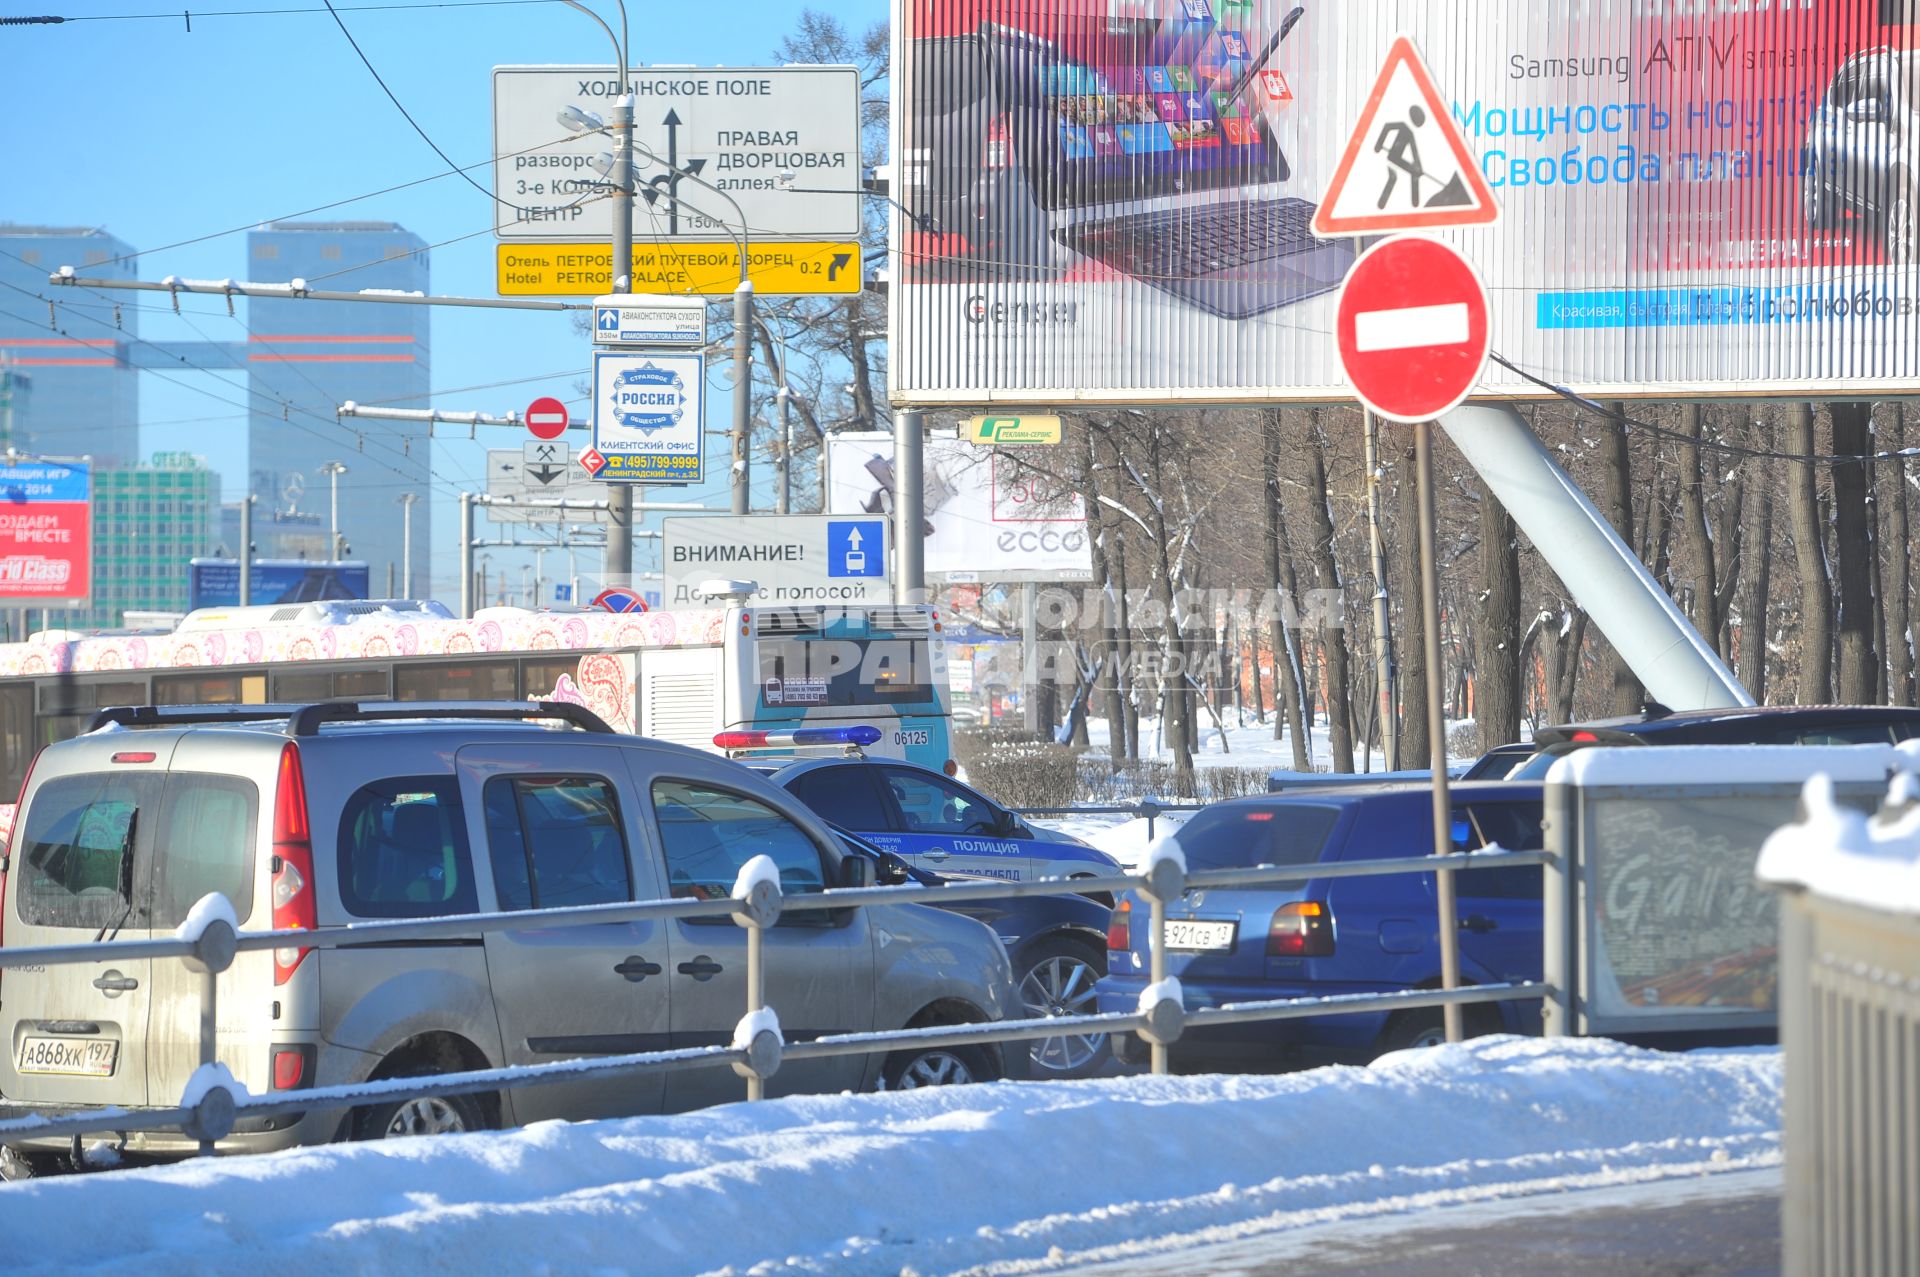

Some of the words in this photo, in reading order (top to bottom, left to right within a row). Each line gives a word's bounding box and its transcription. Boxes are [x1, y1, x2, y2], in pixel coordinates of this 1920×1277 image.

[1510, 54, 1629, 82] Samsung
[1643, 34, 1739, 74] ATIV
[578, 80, 709, 98] ХОДЫНСКОЕ
[716, 80, 771, 96] ПОЛЕ
[1451, 100, 1670, 142] Мощность
[717, 131, 798, 146] ПРАВАЯ
[717, 153, 845, 171] ДВОРЦОВАЯ
[1483, 145, 1661, 187] Свобода
[516, 179, 544, 195] 3-е
[717, 178, 774, 190] аллея
[516, 206, 583, 224] ЦЕНТР
[505, 255, 550, 267] Отель
[660, 253, 728, 267] ПУТЕВОЙ
[732, 254, 793, 268] ДВОРЕЦ
[800, 262, 822, 274] 0.2
[505, 272, 542, 284] Hotel
[1551, 303, 1623, 319] Красивая,
[675, 323, 700, 331] улица
[629, 373, 668, 382] СТРАХОВОЕ
[622, 392, 675, 406] РОССИЯ
[630, 415, 667, 424] ОБЩЕСТВО
[600, 440, 664, 450] КЛИЕНТСКИЙ
[667, 441, 695, 451] ОФИС
[624, 455, 699, 469] (495)799-9999
[15, 529, 72, 543] ВМЕСТЕ
[996, 531, 1083, 553] ecco
[673, 545, 805, 562] ВНИМАНИЕ!
[24, 559, 67, 581] Class
[776, 582, 866, 600] полосой
[894, 731, 928, 746] 06125
[953, 839, 1020, 855] ПОЛИЦИЯ
[26, 1042, 83, 1067] А868ХК
[88, 1042, 112, 1061] 197
